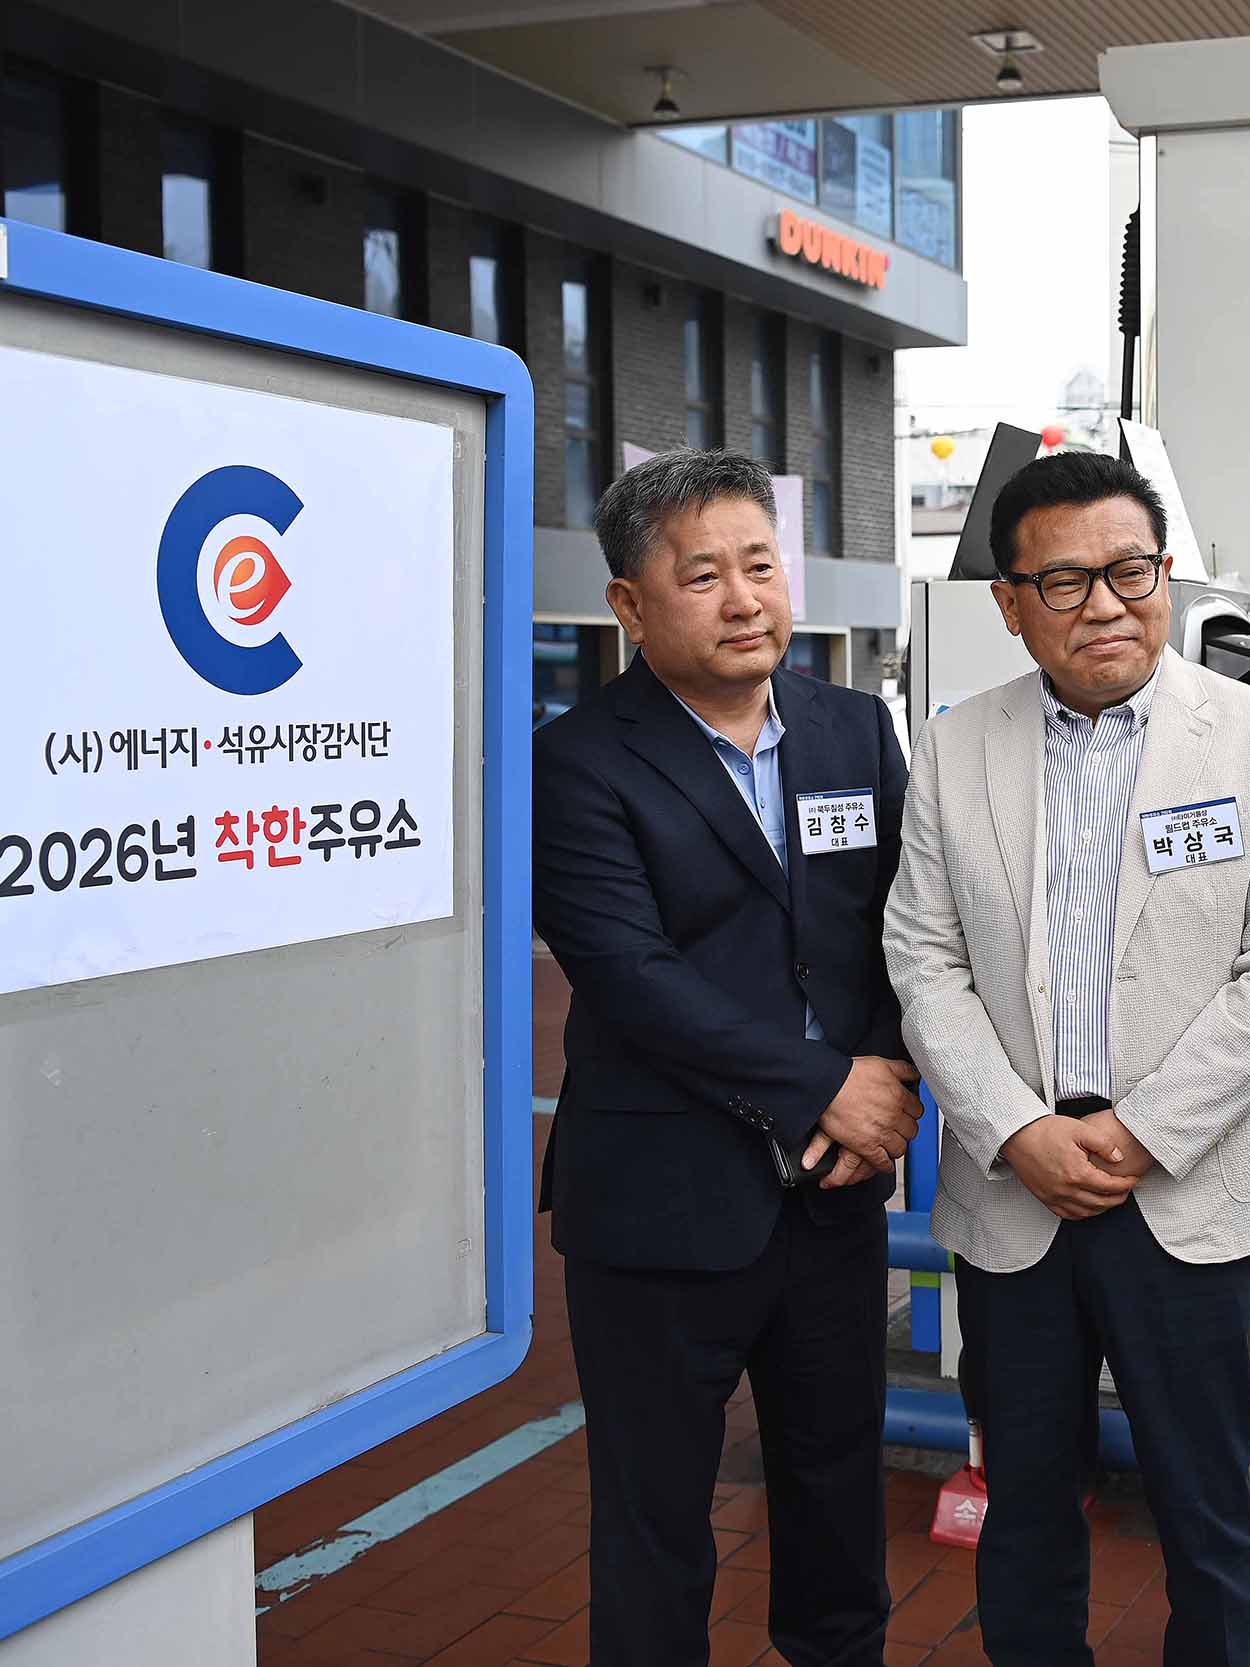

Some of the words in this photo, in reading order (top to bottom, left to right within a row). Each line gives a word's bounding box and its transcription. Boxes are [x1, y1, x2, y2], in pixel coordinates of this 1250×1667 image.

[0, 815, 197, 897] 2026년
[215, 798, 421, 870] 착한주유소
[1192, 817, 1217, 829] 주유소
